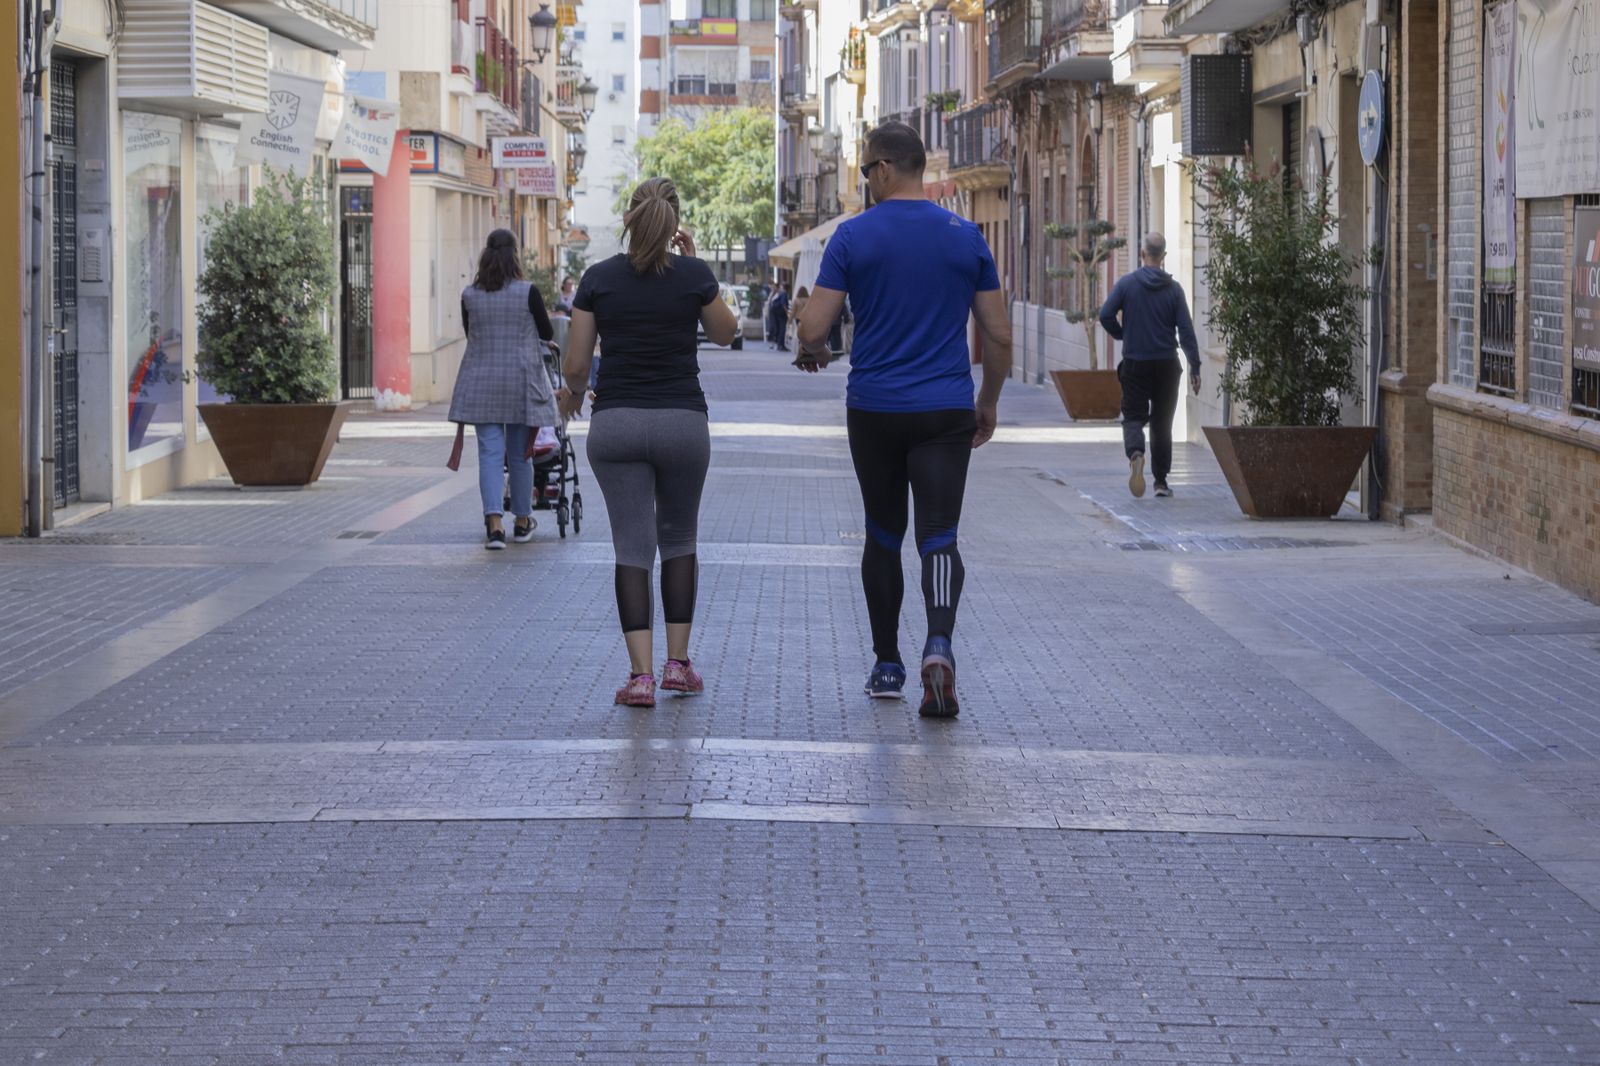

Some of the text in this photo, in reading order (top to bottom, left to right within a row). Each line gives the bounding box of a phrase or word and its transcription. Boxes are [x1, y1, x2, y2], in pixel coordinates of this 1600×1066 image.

[260, 129, 293, 143] English
[344, 123, 388, 145] ROBOTICS
[250, 136, 300, 154] Connection
[345, 135, 380, 156] SCHOOL
[504, 142, 544, 150] COMPUTER
